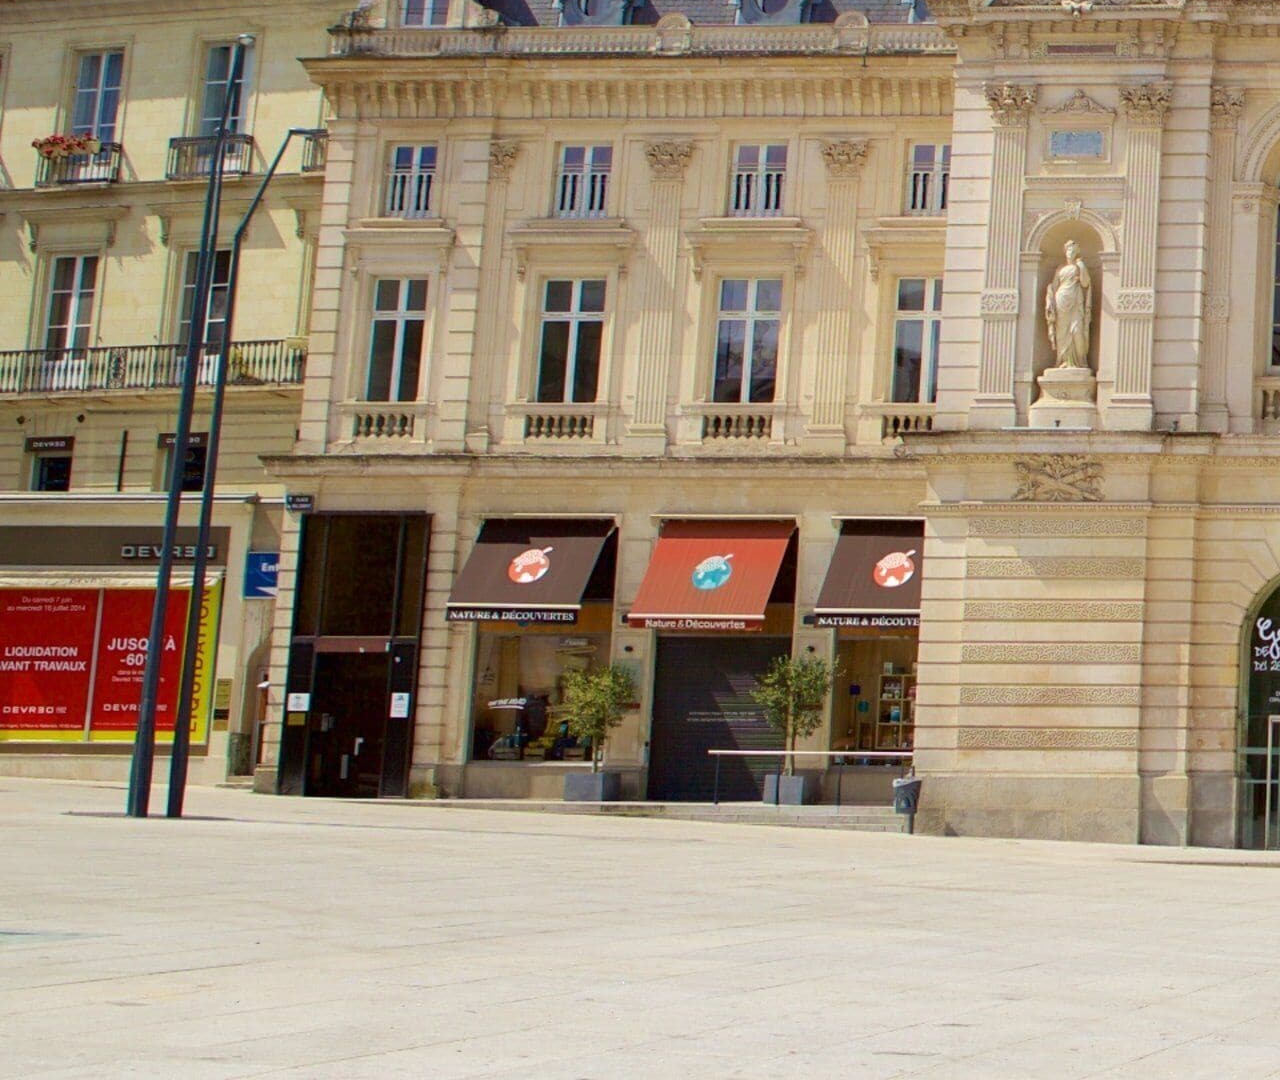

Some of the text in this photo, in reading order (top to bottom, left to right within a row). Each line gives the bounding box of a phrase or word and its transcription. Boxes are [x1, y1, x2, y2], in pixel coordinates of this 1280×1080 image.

[450, 610, 490, 619] NATURE
[501, 610, 574, 620] DÉCOUVERTES
[645, 619, 746, 629] Nature & Découvertes
[818, 617, 860, 626] NATURE
[860, 617, 869, 626] &
[107, 635, 176, 651] JUSQ'À
[5, 647, 78, 657] LIQUIDATION
[33, 661, 86, 671] TRAVAUX
